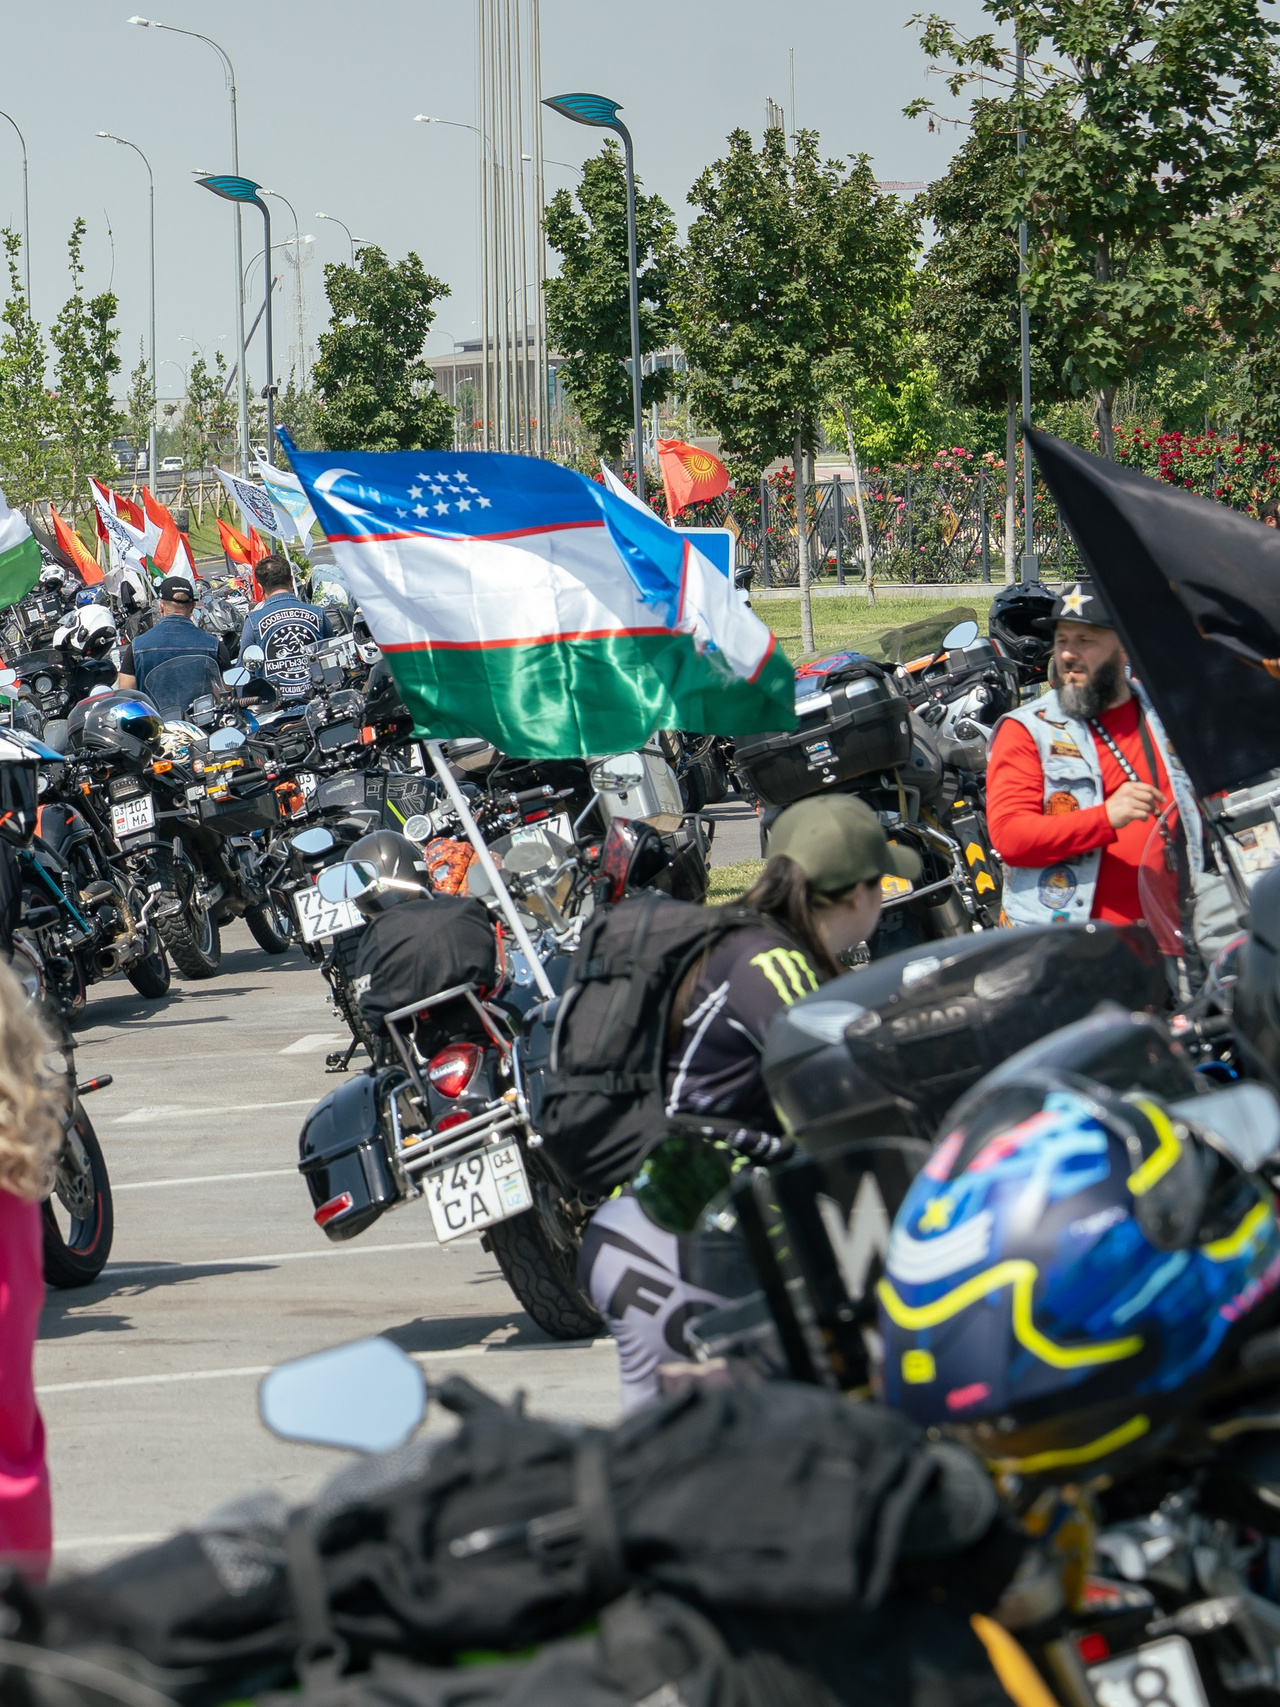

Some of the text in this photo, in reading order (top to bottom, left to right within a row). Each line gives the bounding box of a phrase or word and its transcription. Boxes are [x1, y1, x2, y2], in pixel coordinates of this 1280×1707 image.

[261, 610, 315, 629] СООБЩЕСТВО
[267, 657, 308, 671] КЫРГЫЗС
[128, 799, 148, 815] 101
[132, 813, 148, 826] MA
[298, 889, 323, 915] 77
[308, 908, 343, 937] ZZ
[493, 1149, 514, 1168] 01
[427, 1154, 484, 1201] 749
[506, 1194, 521, 1207] UZ
[444, 1191, 490, 1230] CA
